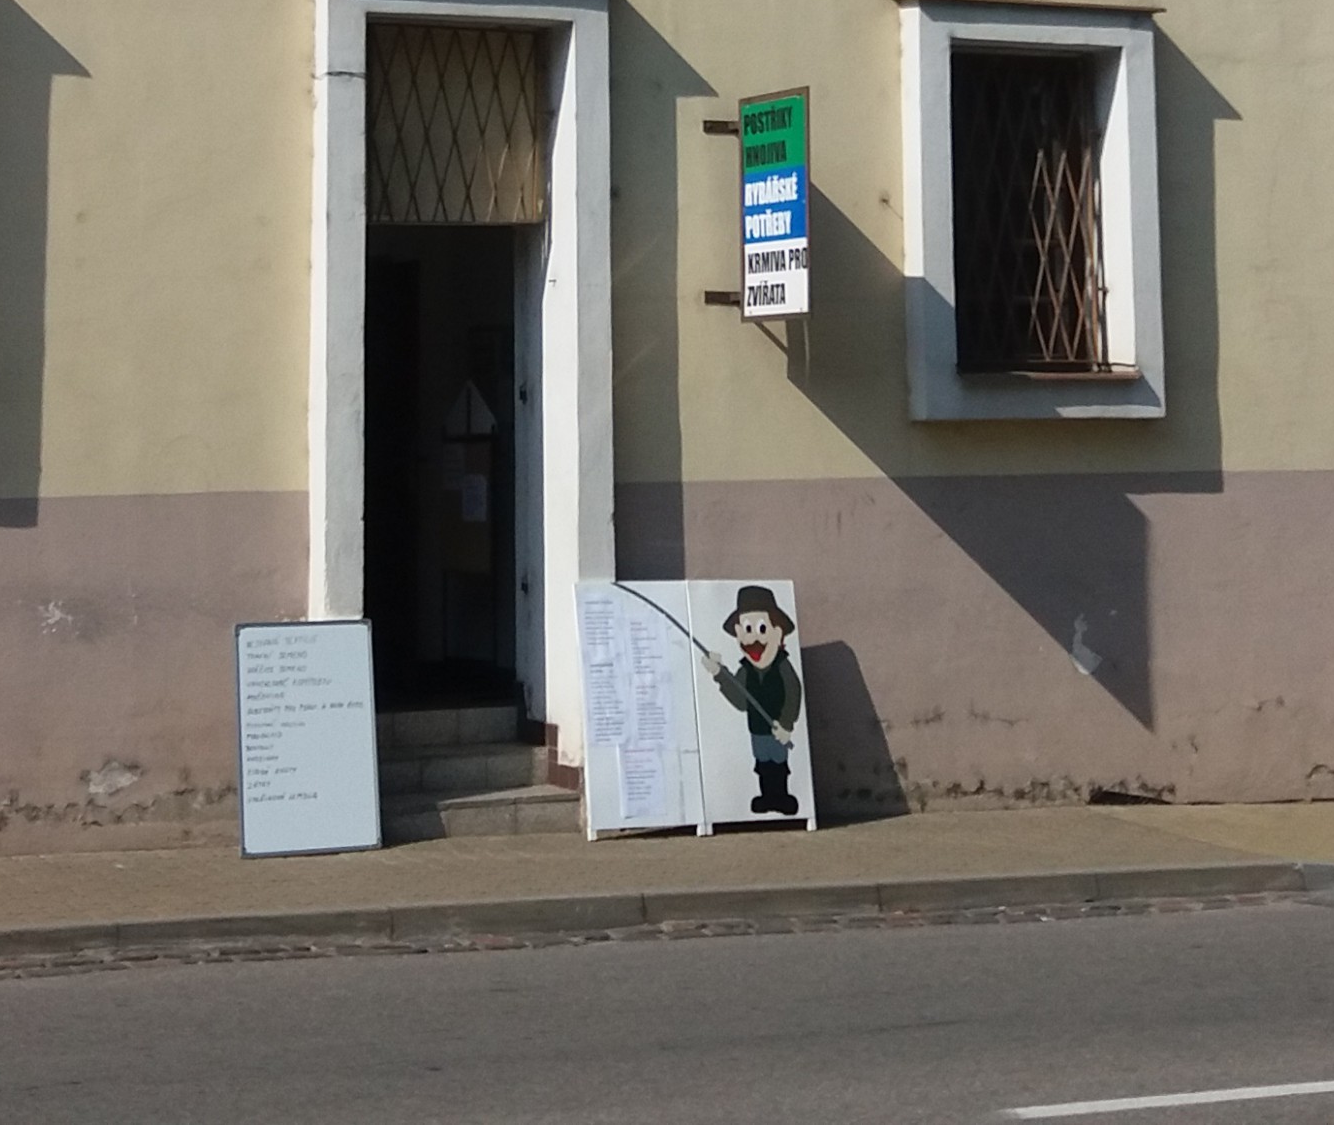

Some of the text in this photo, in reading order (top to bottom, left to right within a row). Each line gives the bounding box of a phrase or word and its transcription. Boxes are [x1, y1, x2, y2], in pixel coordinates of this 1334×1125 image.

[743, 105, 792, 137] POSTŘIKY
[745, 140, 787, 168] HNOJIVA
[744, 171, 798, 208] RYBÁŘSKÉ
[744, 208, 792, 240] POTŘEBY
[747, 247, 808, 275] KRMIVA PRO
[747, 280, 786, 307] ZVÍŘATA
